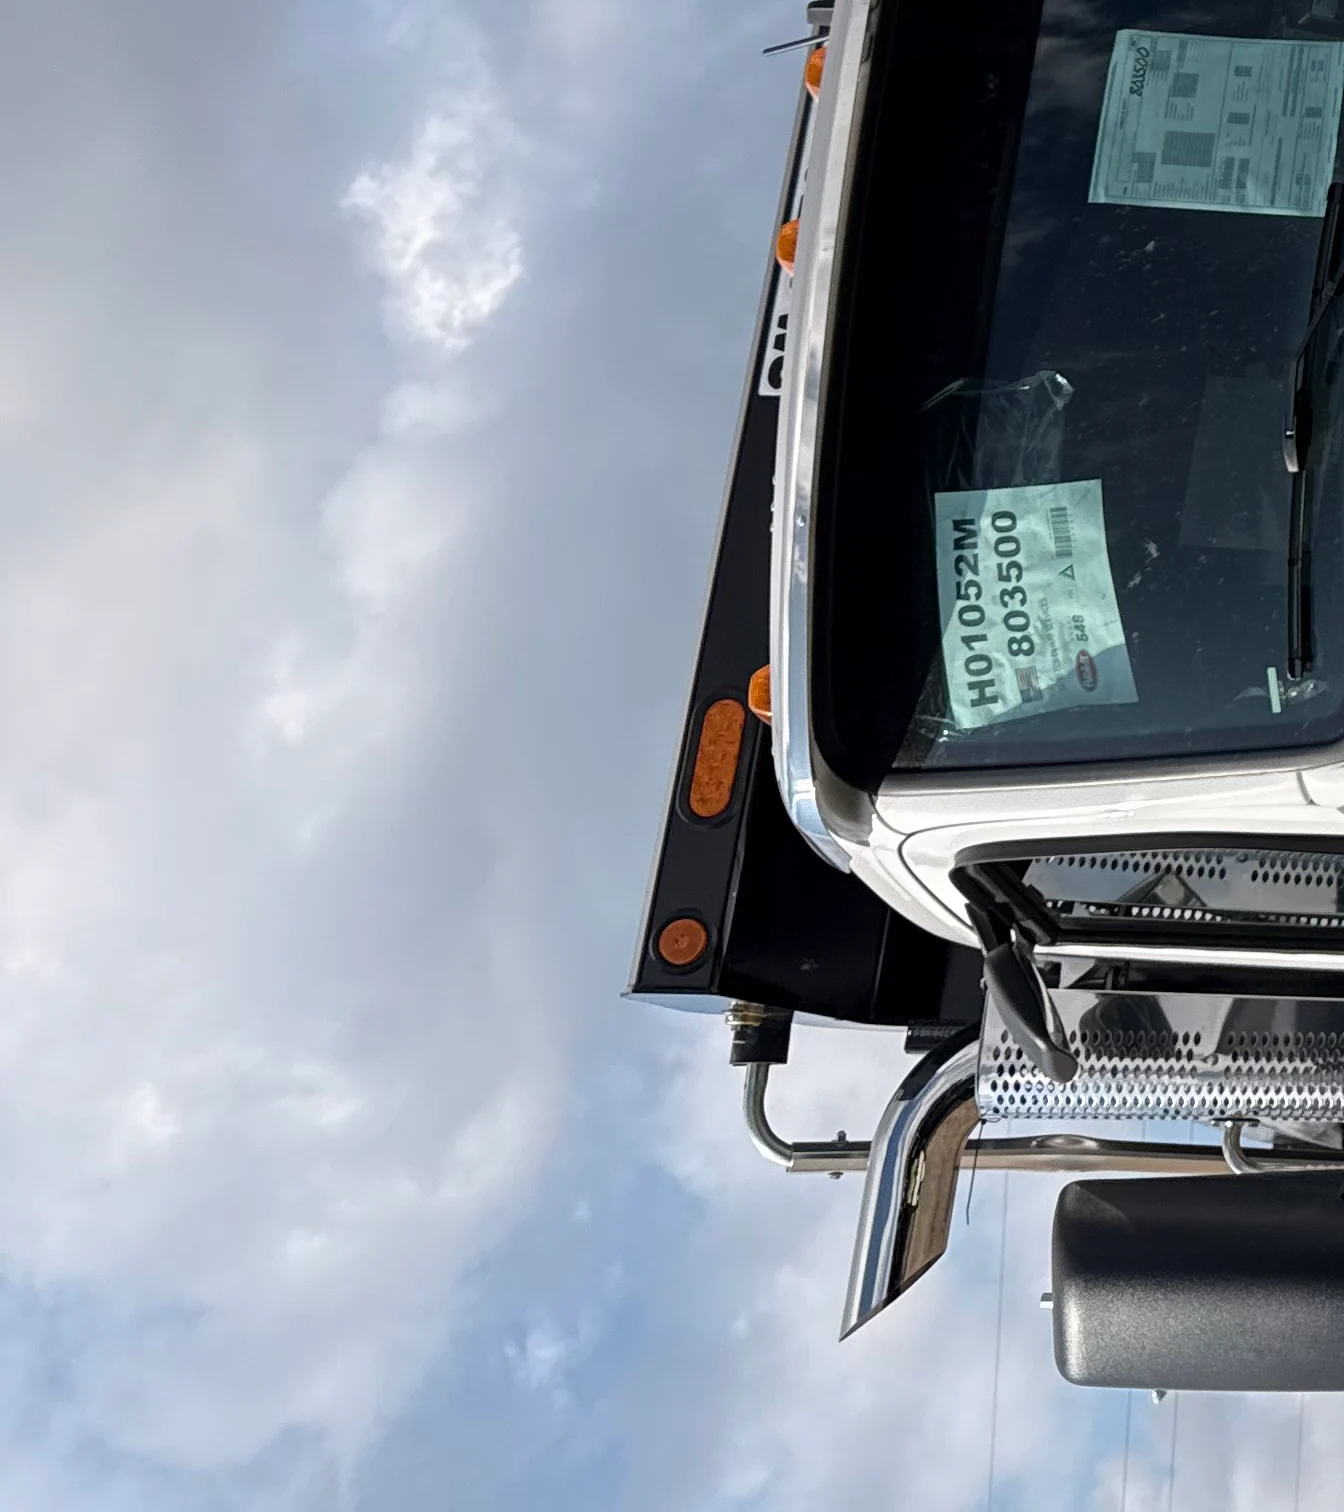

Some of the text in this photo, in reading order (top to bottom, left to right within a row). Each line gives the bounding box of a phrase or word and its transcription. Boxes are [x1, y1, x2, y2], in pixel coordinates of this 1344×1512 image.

[1129, 46, 1150, 97] 803500
[952, 517, 999, 708] H01052M
[991, 510, 1035, 657] 803500
